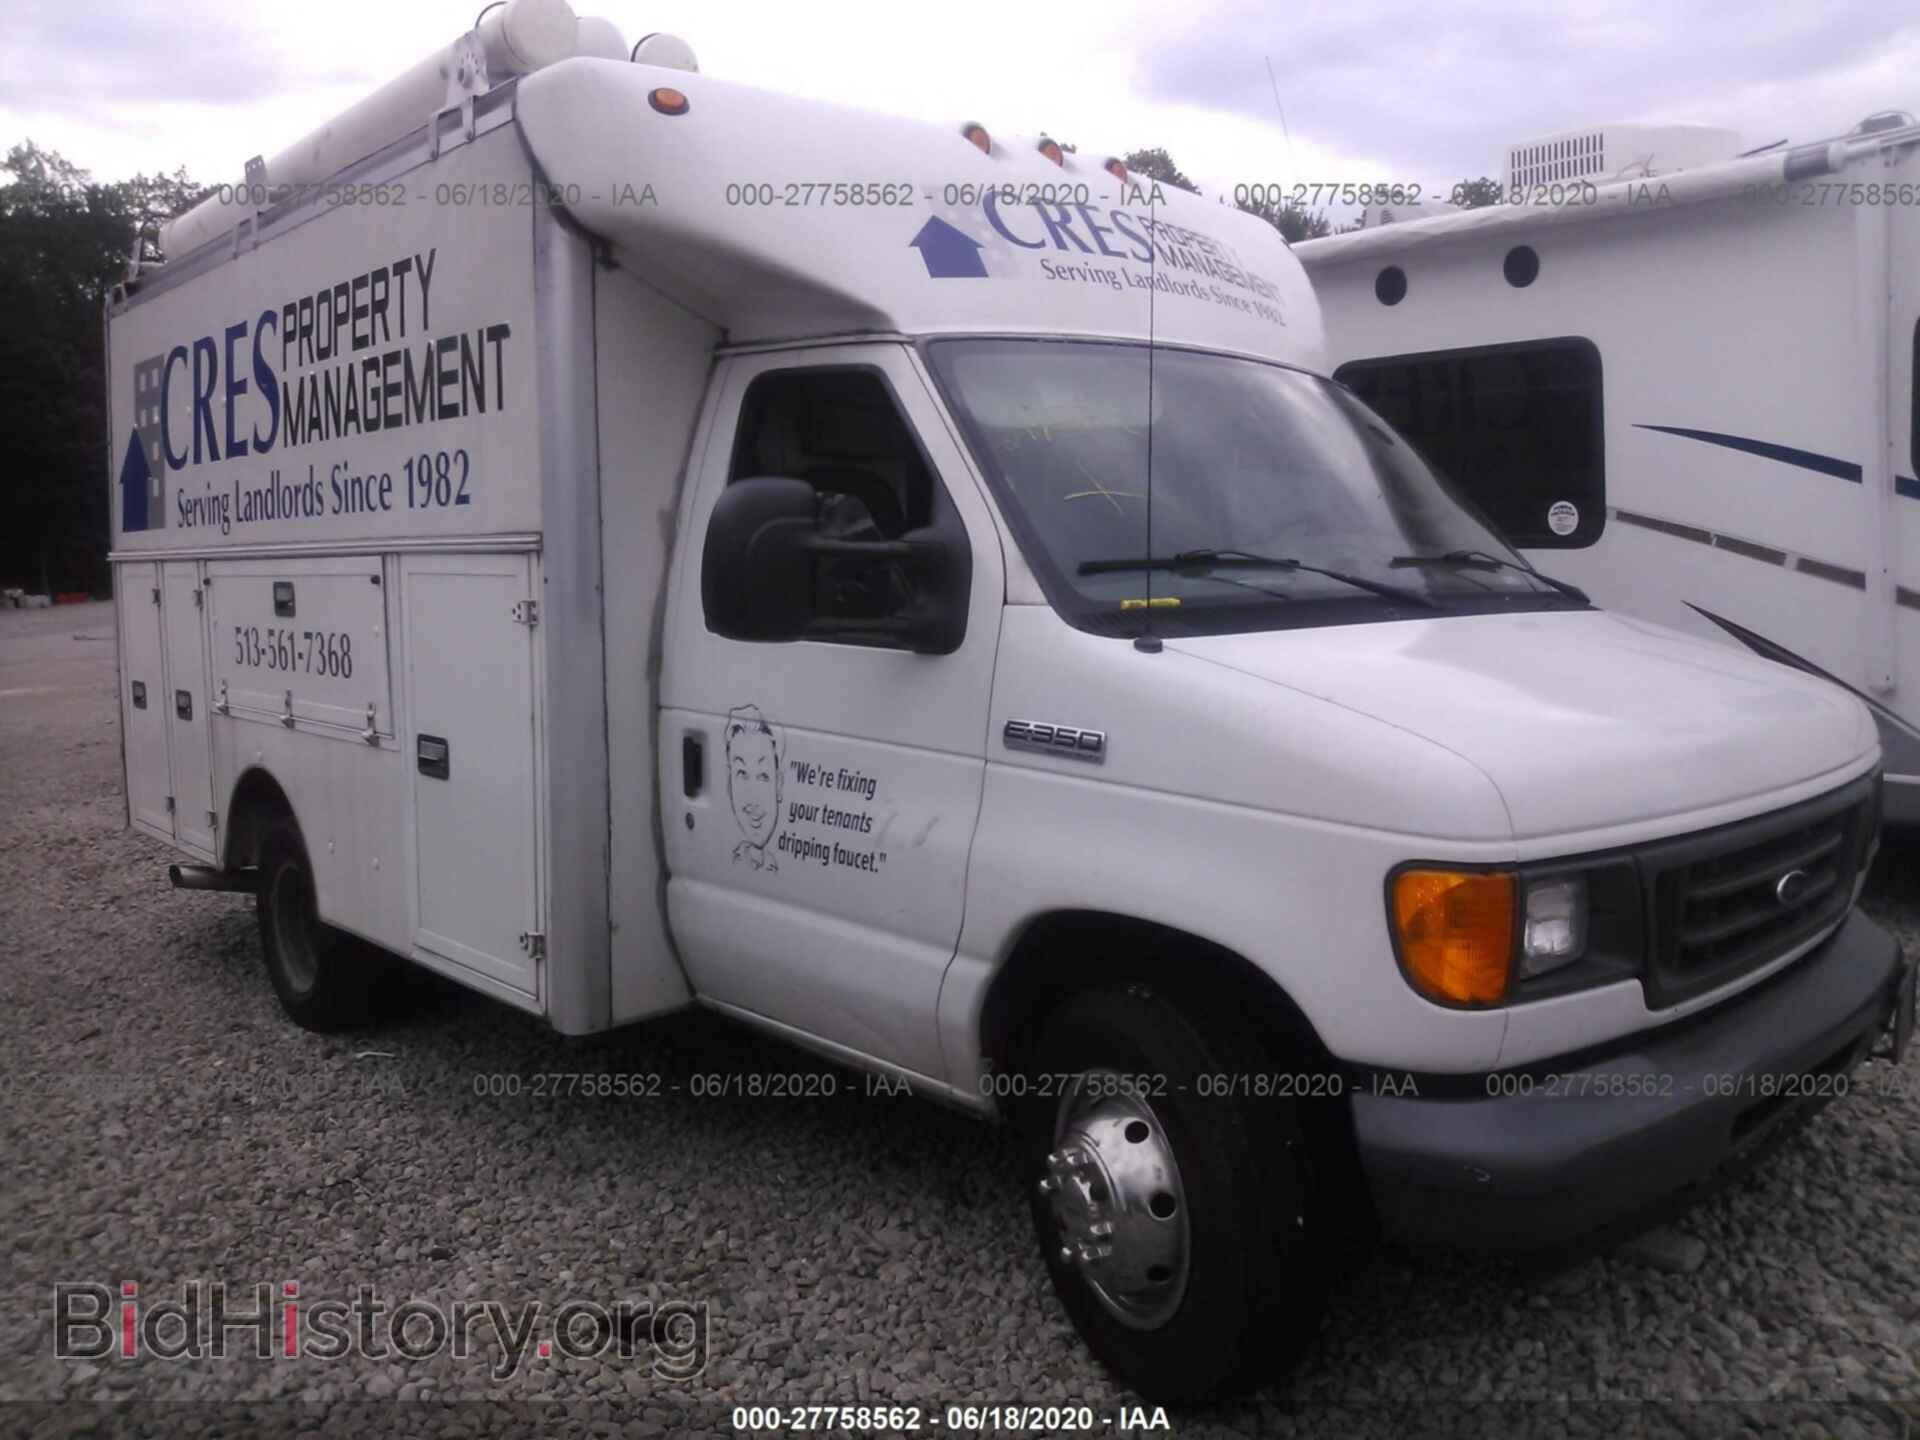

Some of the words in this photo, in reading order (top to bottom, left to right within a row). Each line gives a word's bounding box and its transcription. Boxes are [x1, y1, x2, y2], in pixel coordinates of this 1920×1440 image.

[982, 191, 1153, 263] CRES
[281, 247, 437, 373] PROPERTY
[1040, 258, 1123, 290] Serving
[1121, 267, 1210, 301] Landlords
[160, 309, 280, 471] CRES
[281, 322, 511, 449] MANAGEMENT
[177, 484, 231, 535] Serving
[234, 464, 324, 524] Landlords
[331, 460, 392, 515] Since
[403, 449, 472, 509] 1982
[234, 626, 353, 680] 513-561-7368
[790, 760, 834, 788] "We're
[837, 767, 877, 801] fixing
[788, 801, 819, 823] your
[821, 804, 873, 834] tenants
[777, 829, 830, 867] dripping
[833, 842, 888, 873] faucet."
